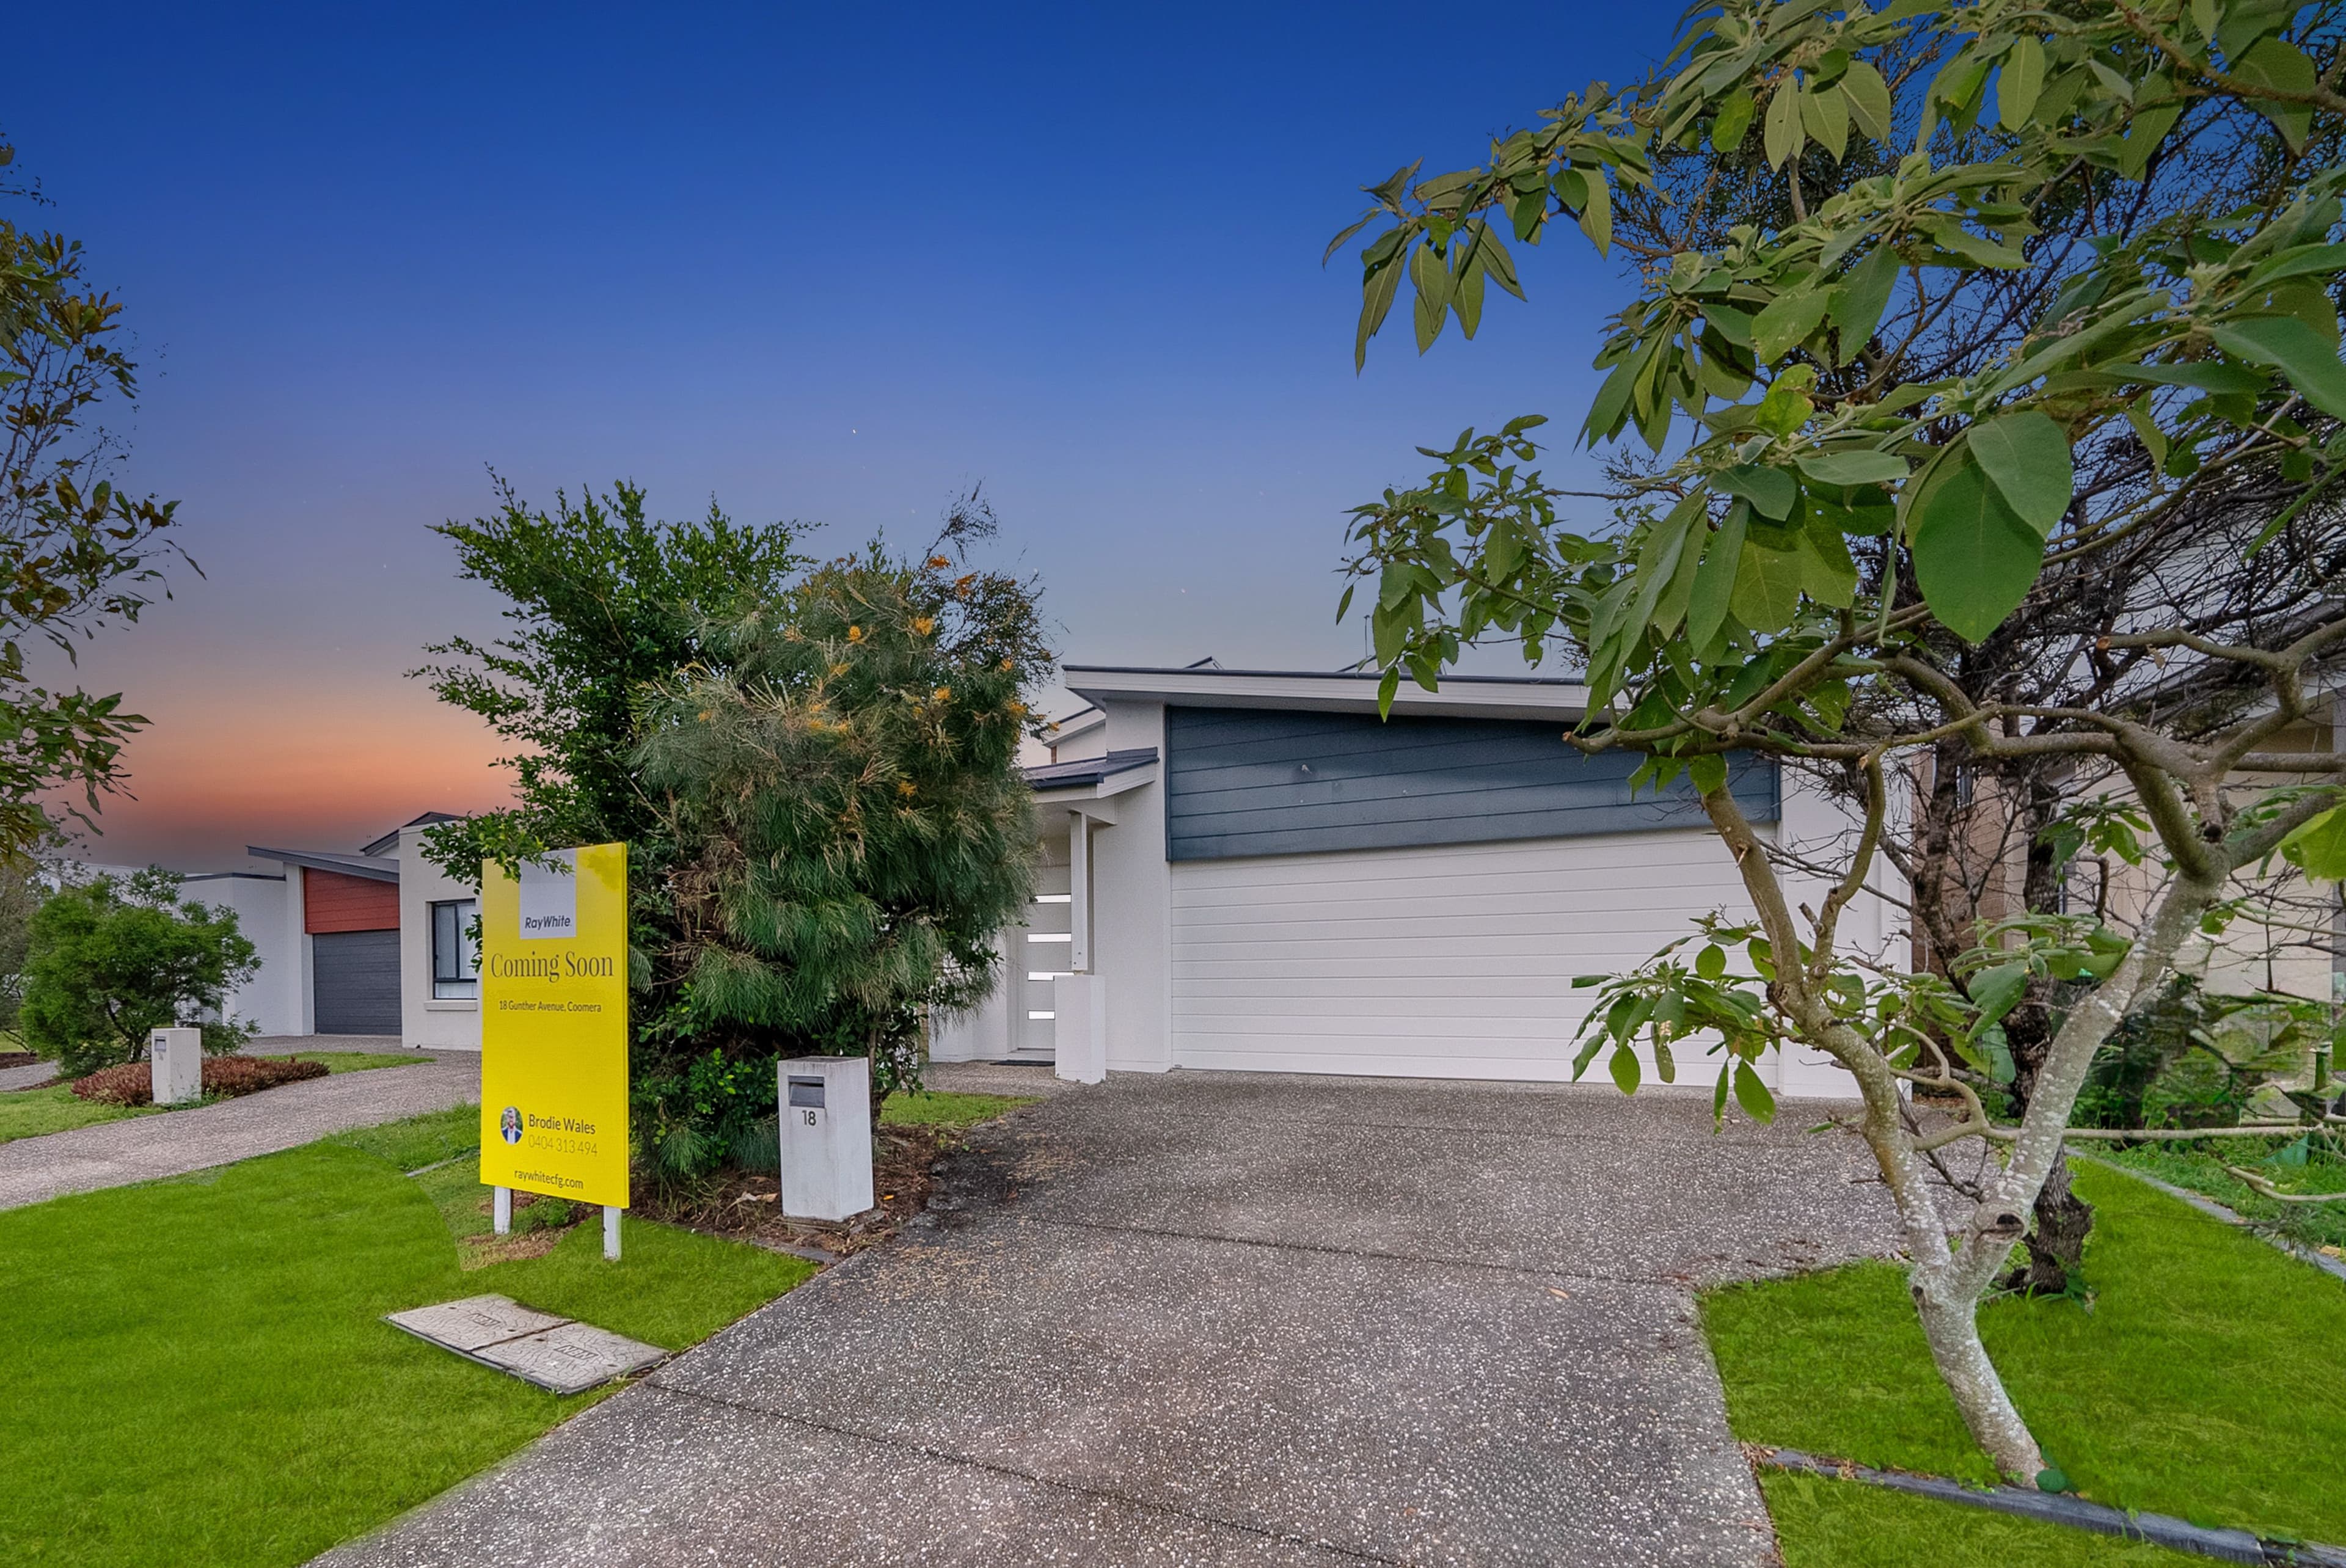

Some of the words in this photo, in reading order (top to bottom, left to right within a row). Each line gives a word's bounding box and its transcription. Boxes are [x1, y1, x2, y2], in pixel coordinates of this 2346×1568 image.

[491, 951, 560, 983] Coming
[565, 950, 613, 977] Soon
[499, 1001, 507, 1010] 18
[508, 1001, 536, 1011] Gunther
[538, 1001, 566, 1012] Avenue,
[567, 1001, 602, 1012] Coomera
[528, 1114, 561, 1130] Brodie
[563, 1117, 596, 1134] Wales
[802, 1110, 817, 1126] 18
[528, 1134, 554, 1150] 0404
[556, 1137, 576, 1153] 313
[577, 1141, 598, 1157] 494
[514, 1170, 584, 1189] raywhitecfg.com
